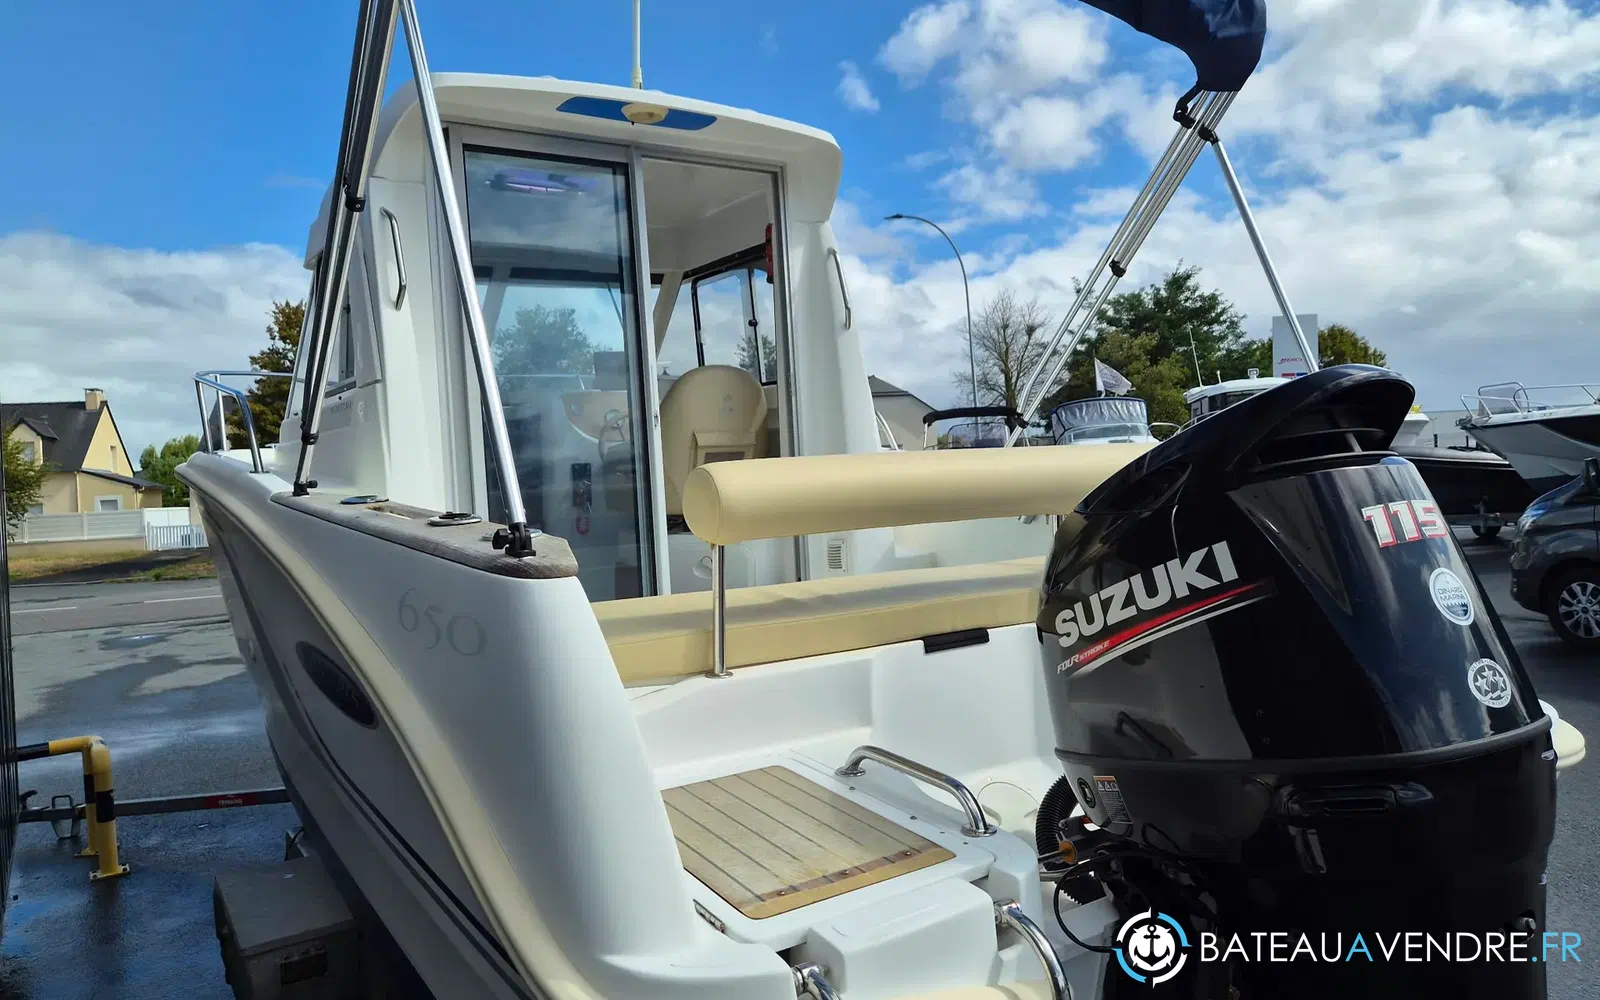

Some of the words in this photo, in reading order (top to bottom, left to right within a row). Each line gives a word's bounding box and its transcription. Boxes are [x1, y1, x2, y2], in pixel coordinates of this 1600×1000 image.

[1361, 499, 1447, 548] 115
[1055, 540, 1239, 648] SUZUKI
[1437, 586, 1463, 596] DINARD
[397, 587, 488, 656] 650
[1057, 653, 1080, 675] FOUR
